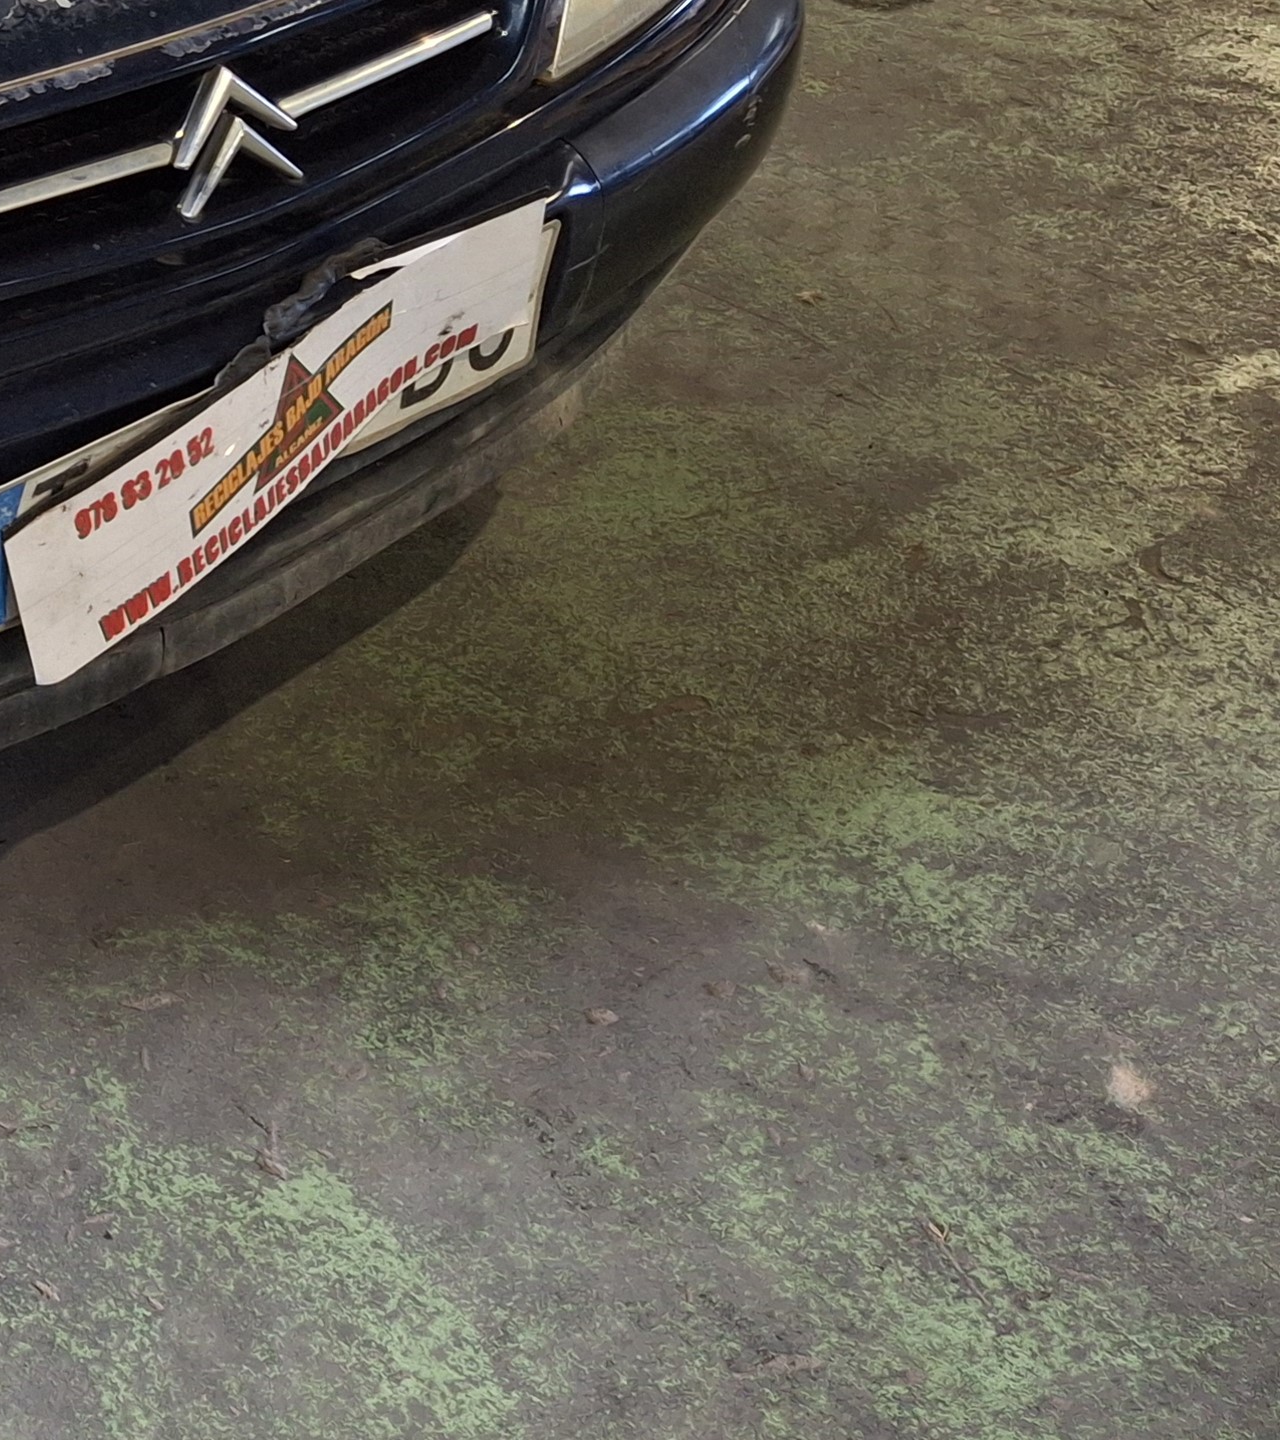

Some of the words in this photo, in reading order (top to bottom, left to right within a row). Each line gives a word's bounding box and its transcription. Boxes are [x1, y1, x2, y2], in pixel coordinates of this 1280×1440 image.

[74, 491, 118, 540] 978
[121, 470, 152, 510] 83
[187, 427, 215, 467] 52
[193, 421, 284, 530] RECICLAJES
[285, 375, 323, 432] BAJO
